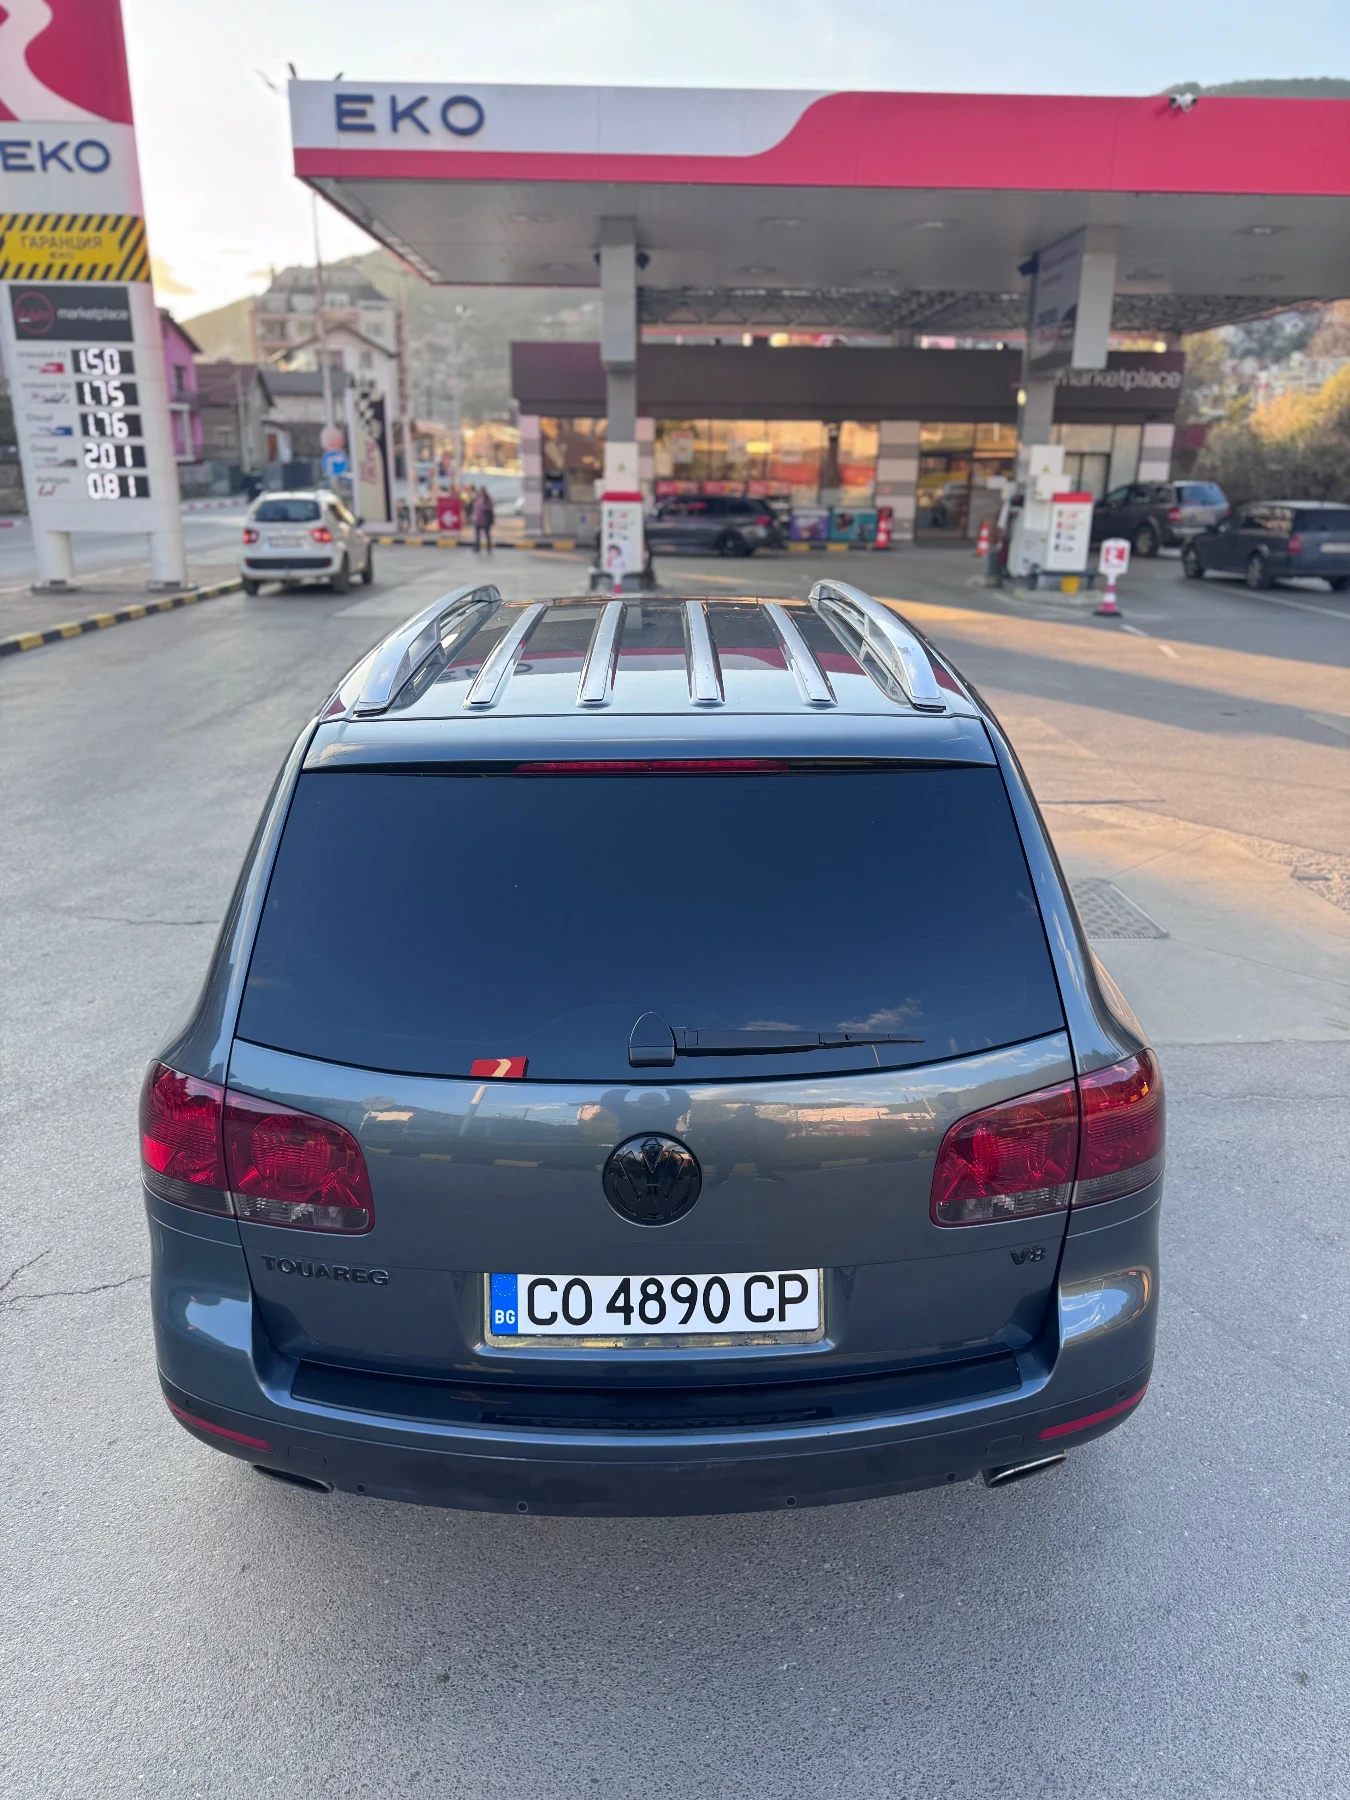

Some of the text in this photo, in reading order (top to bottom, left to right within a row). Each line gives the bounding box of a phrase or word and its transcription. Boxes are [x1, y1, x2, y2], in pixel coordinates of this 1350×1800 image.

[334, 94, 485, 136] EKO
[0, 139, 111, 173] EKO
[57, 307, 129, 322] marketplace
[260, 1254, 389, 1286] TOUAREG
[1010, 1246, 1045, 1265] V8
[526, 1273, 808, 1326] CO 4890 CP
[494, 1309, 516, 1325] BG
